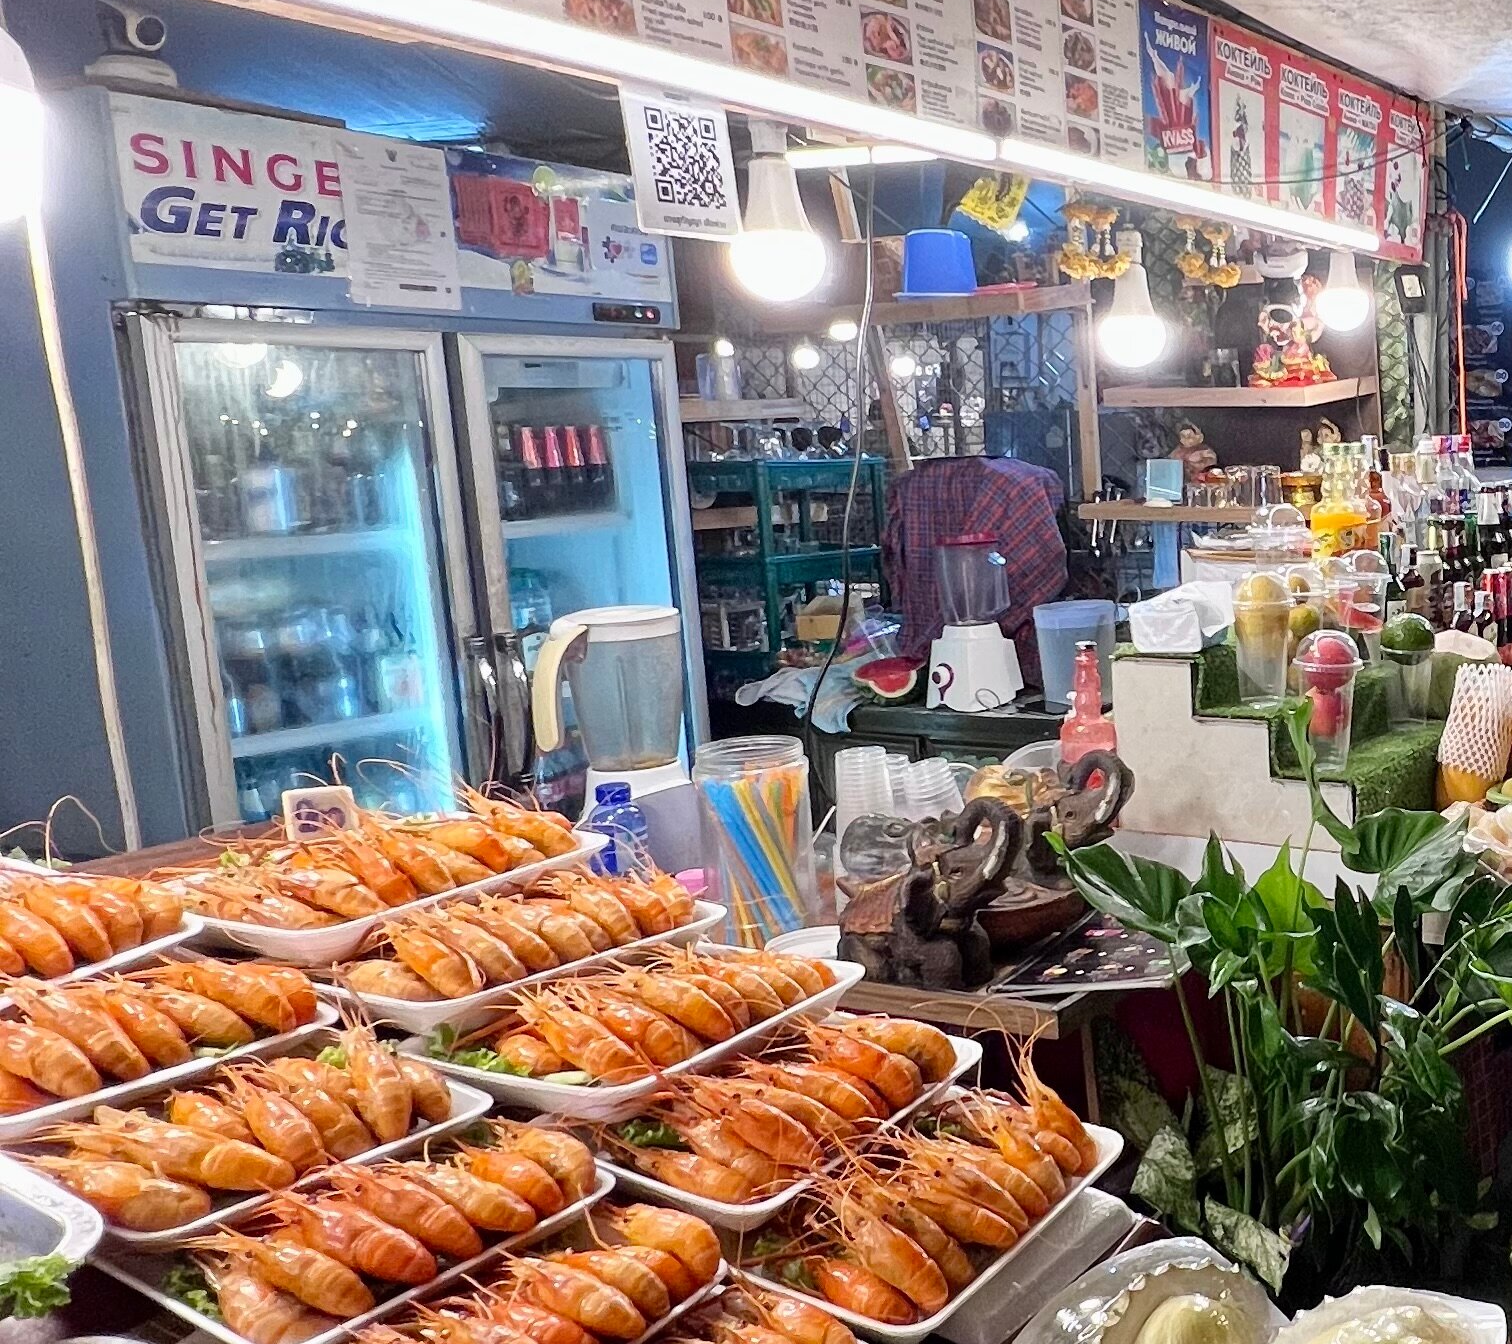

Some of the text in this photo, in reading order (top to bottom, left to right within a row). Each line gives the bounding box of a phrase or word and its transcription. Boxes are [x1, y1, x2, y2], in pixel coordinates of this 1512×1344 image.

[1155, 29, 1197, 55] ЖИВОЙ
[1216, 40, 1271, 75] КОКТЕЙЛЬ
[1280, 66, 1329, 99] КОКТЕЙЛЬ
[1340, 92, 1381, 120] КОКТЕЙЛЬ
[1161, 127, 1195, 147] KVASS
